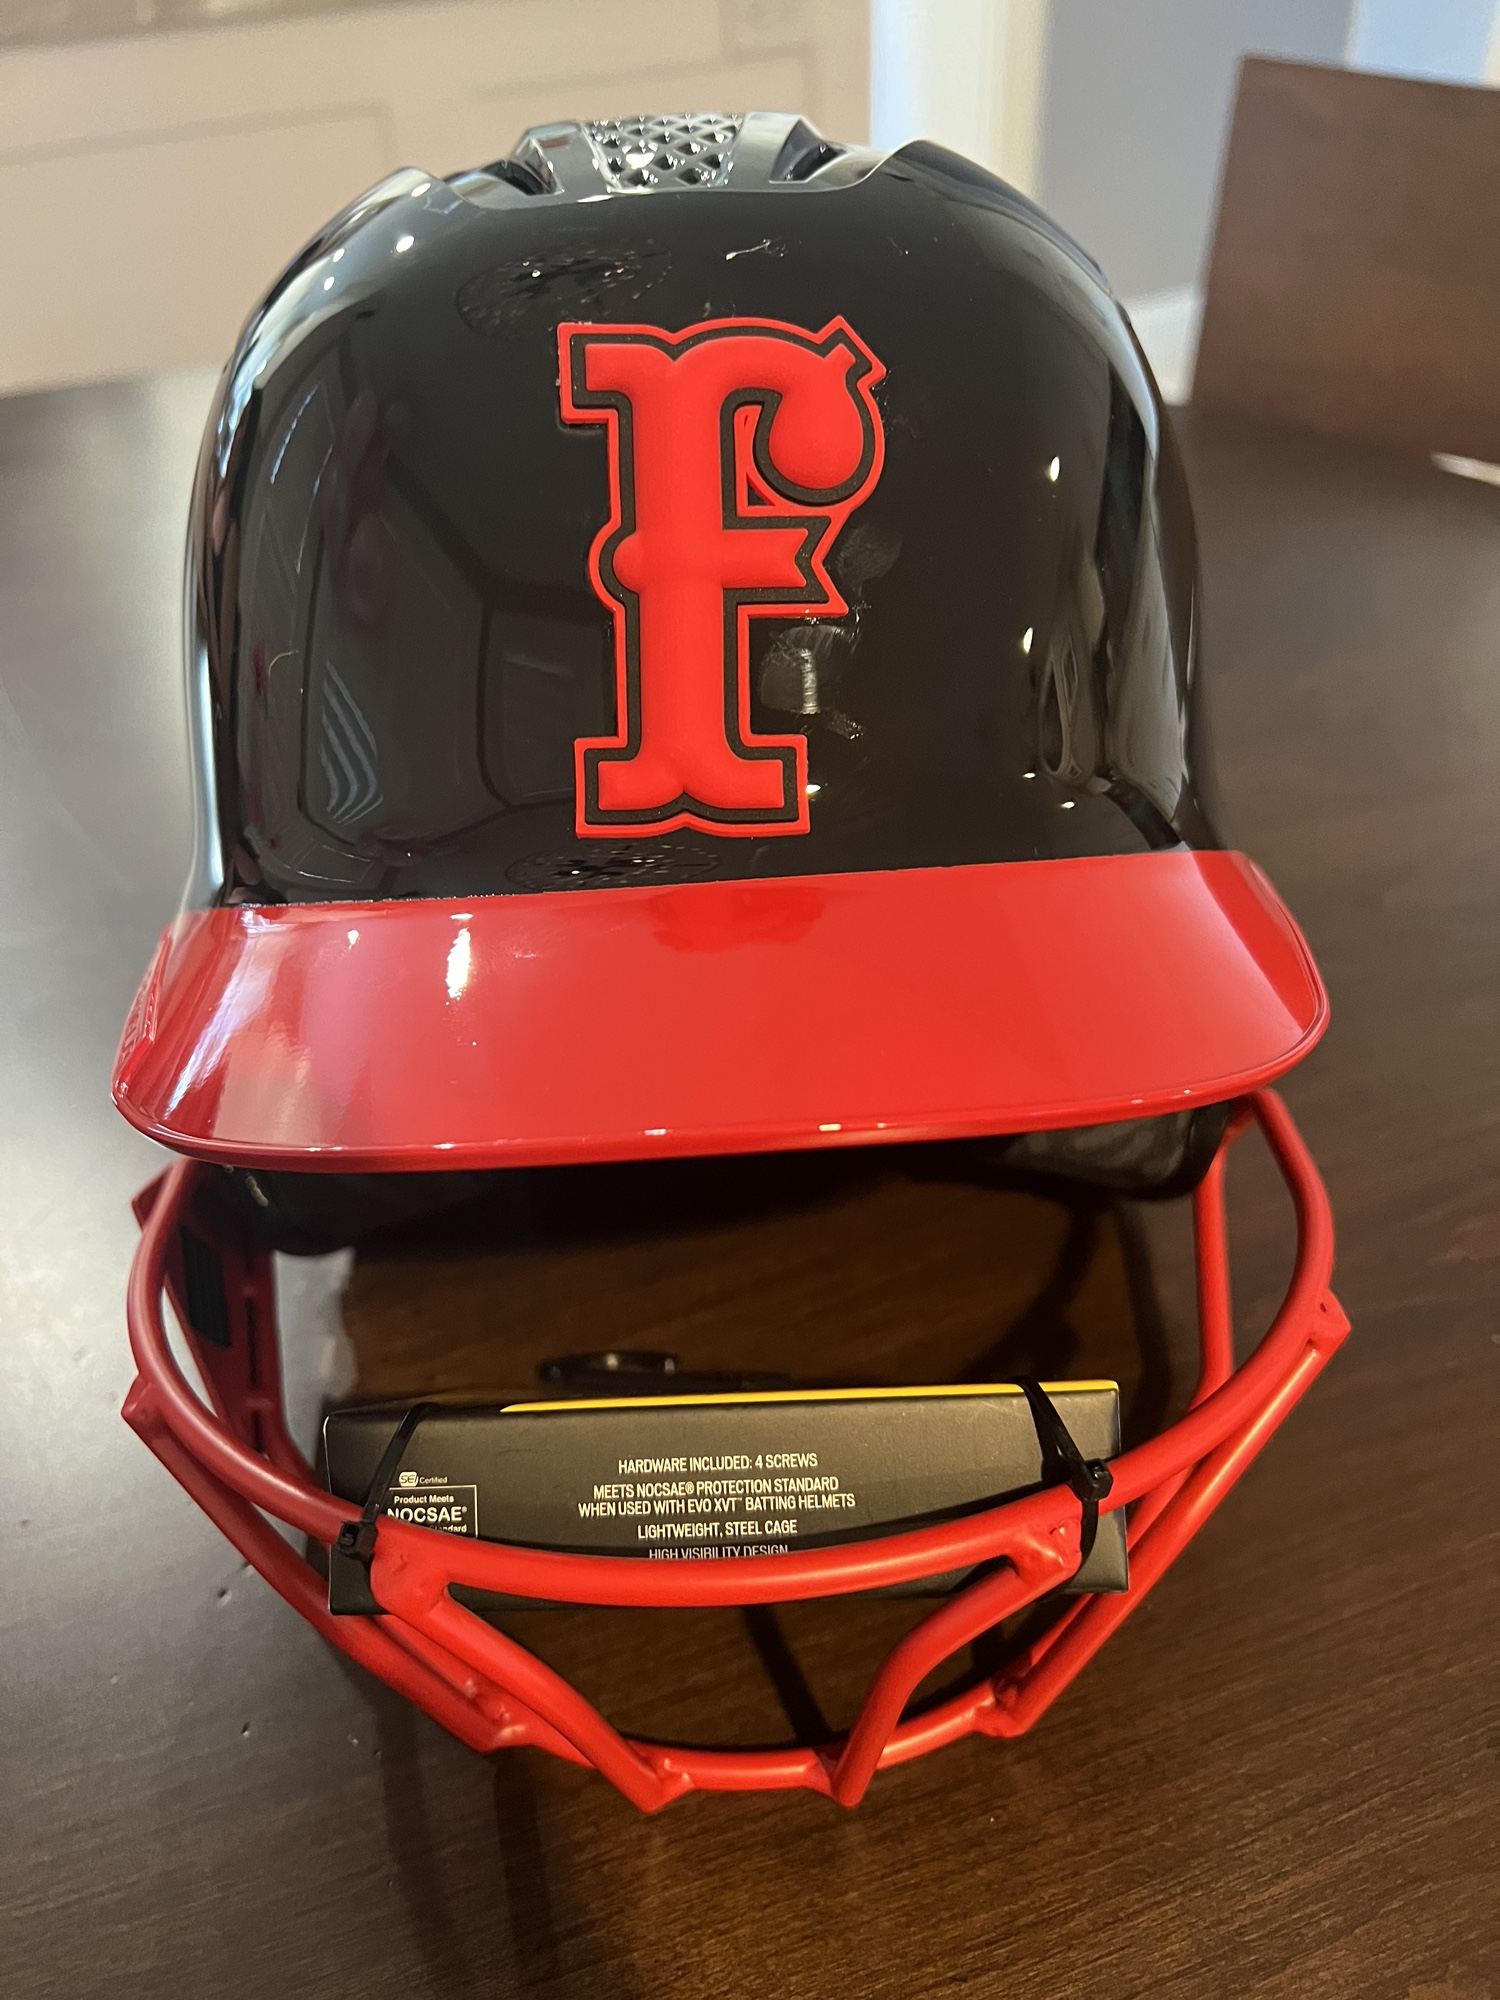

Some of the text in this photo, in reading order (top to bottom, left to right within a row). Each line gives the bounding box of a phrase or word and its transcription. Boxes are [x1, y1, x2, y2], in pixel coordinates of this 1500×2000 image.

[618, 1453, 818, 1474] HARDWARE INCLUDED: 4 SCREWS
[419, 1476, 448, 1484] Certified
[593, 1484, 634, 1499] MEETS
[696, 1479, 772, 1495] PROTECTION
[774, 1477, 839, 1492] STANDARD
[394, 1495, 454, 1504] Product Meets
[578, 1501, 616, 1518] WHEN
[618, 1500, 651, 1516] USED
[653, 1499, 685, 1515] WITH
[688, 1497, 712, 1513] EVO
[745, 1495, 797, 1511] BATTING
[799, 1493, 856, 1509] HELMETS
[637, 1519, 798, 1539] LIGHTWEIGHT, STEEL CAGE
[649, 1548, 679, 1560] HIGH
[681, 1545, 741, 1559] VISIBILITY
